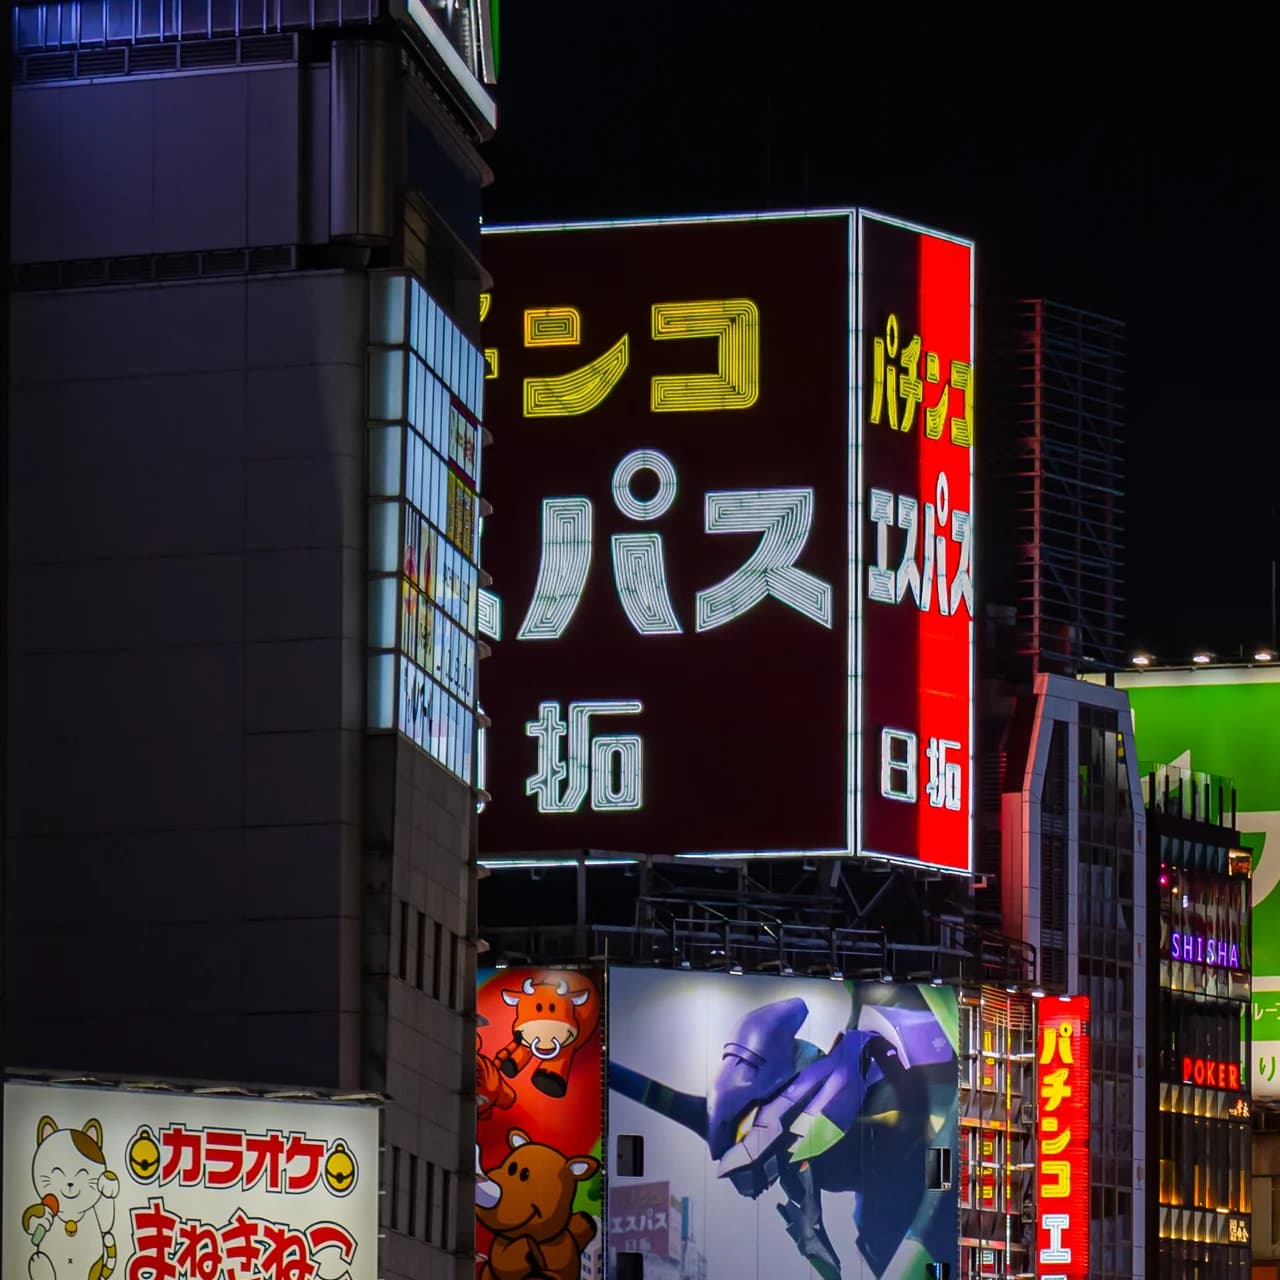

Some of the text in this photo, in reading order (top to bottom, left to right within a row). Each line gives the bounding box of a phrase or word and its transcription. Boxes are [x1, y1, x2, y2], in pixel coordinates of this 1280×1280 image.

[869, 312, 974, 448] パチンコ
[867, 470, 974, 617] エスパス
[879, 725, 962, 812] 日拓
[1170, 932, 1240, 969] SHISHA
[1038, 1022, 1074, 1200] パチンコ
[1183, 1055, 1240, 1090] POKER
[160, 1122, 327, 1195] カラオケ
